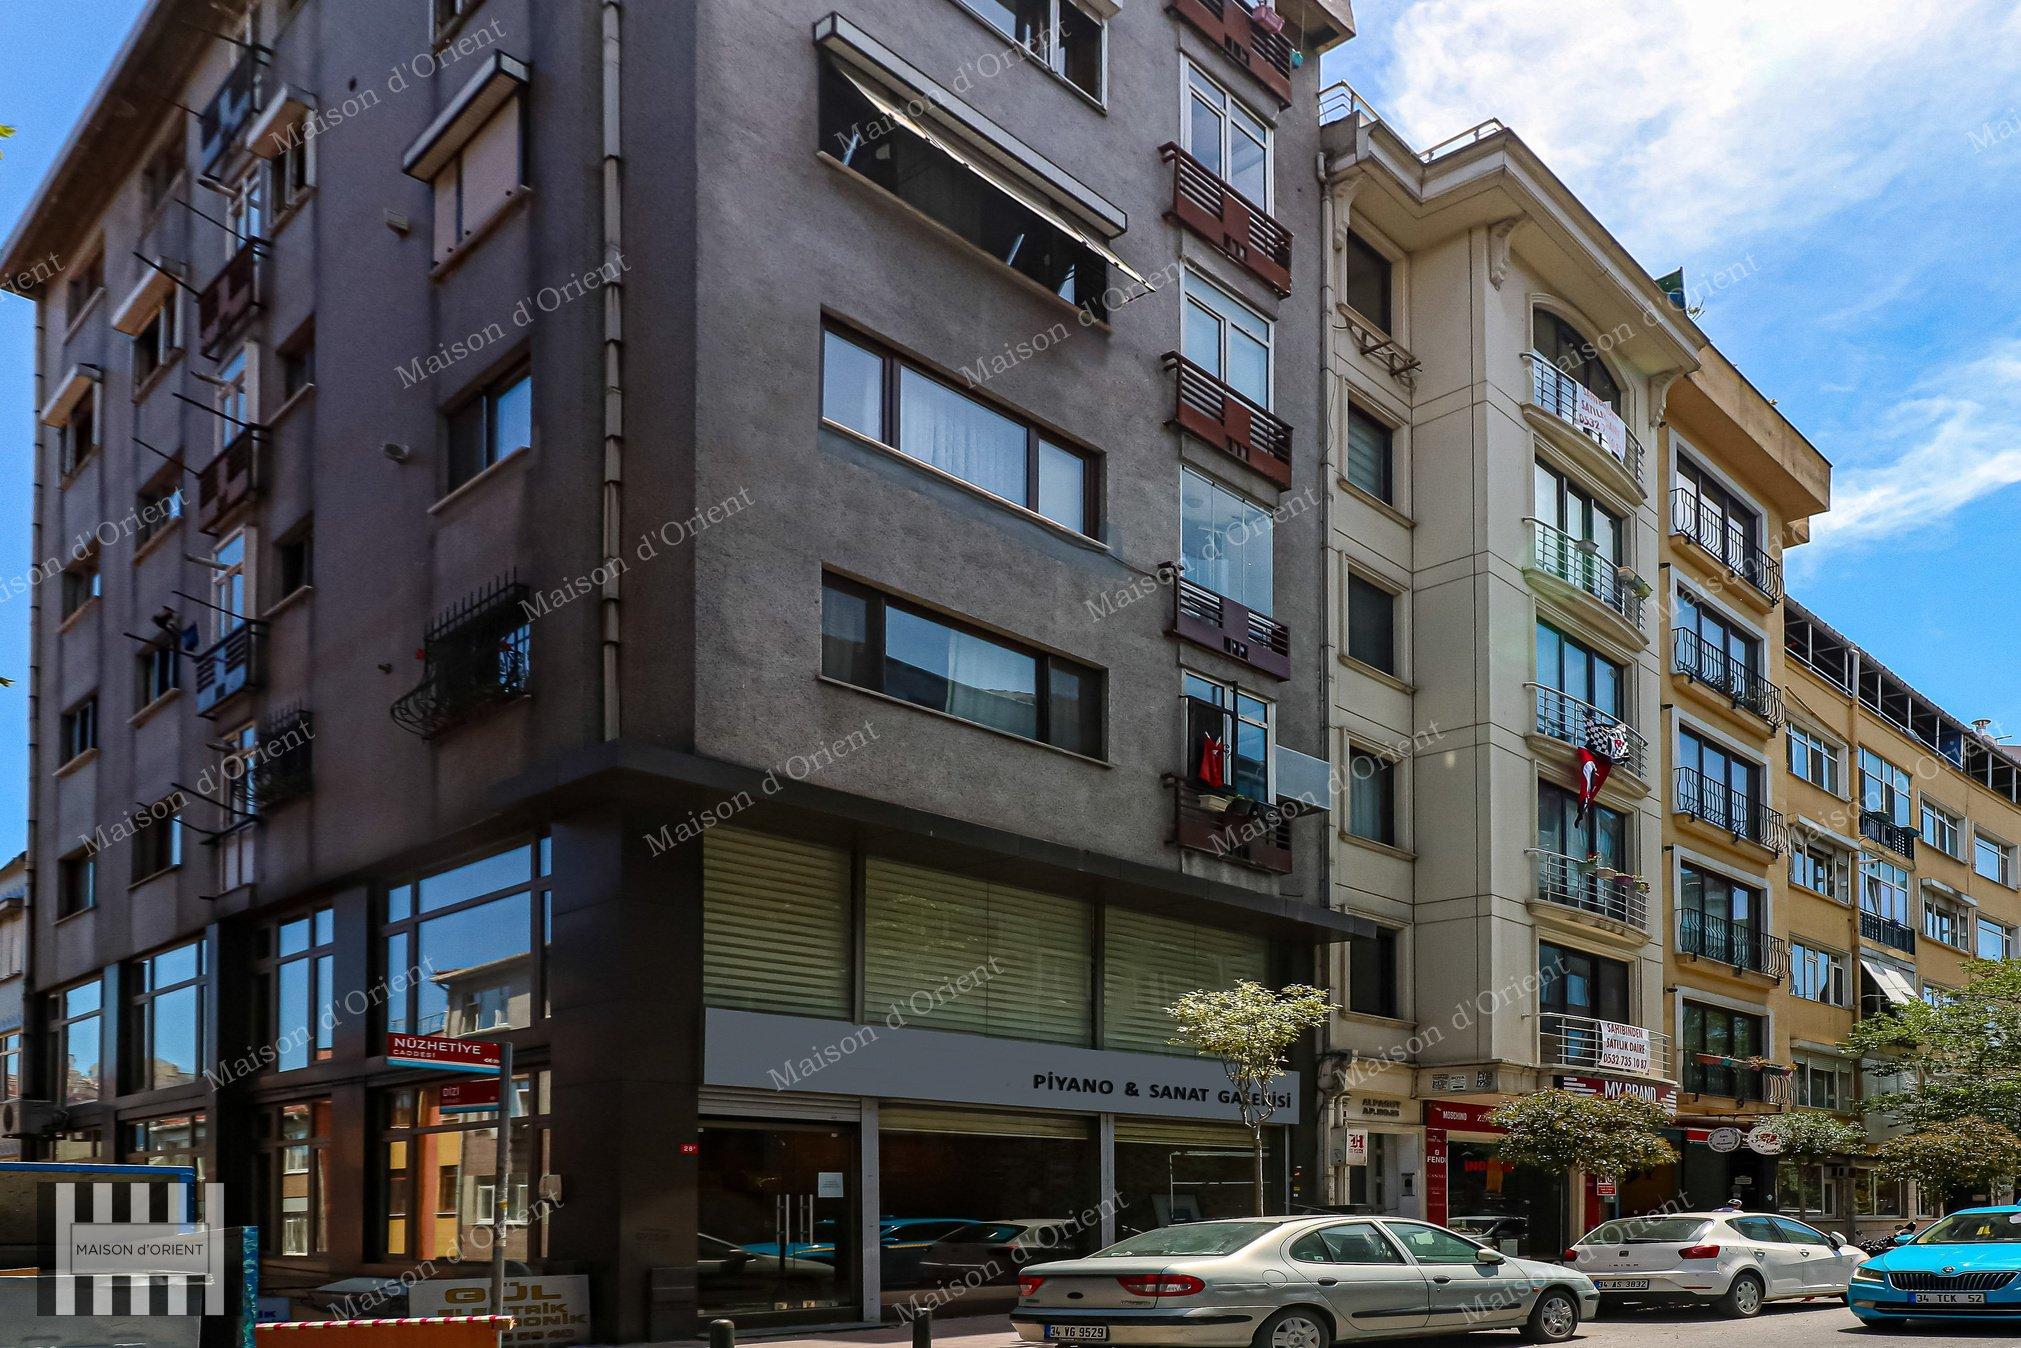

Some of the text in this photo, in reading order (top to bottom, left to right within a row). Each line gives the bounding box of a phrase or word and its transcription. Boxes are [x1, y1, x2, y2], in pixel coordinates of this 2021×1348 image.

[1604, 1054, 1620, 1064] 0532
[1620, 1055, 1632, 1066] 735
[1633, 1058, 1640, 1068] 10
[1033, 1072, 1291, 1108] PİYANO & SANAT GAERİSİ
[1604, 1081, 1656, 1102] MY BRAND
[1916, 1294, 1982, 1302] 34 TCK 52
[1050, 1326, 1060, 1336] 34
[1080, 1328, 1104, 1338] 9529
